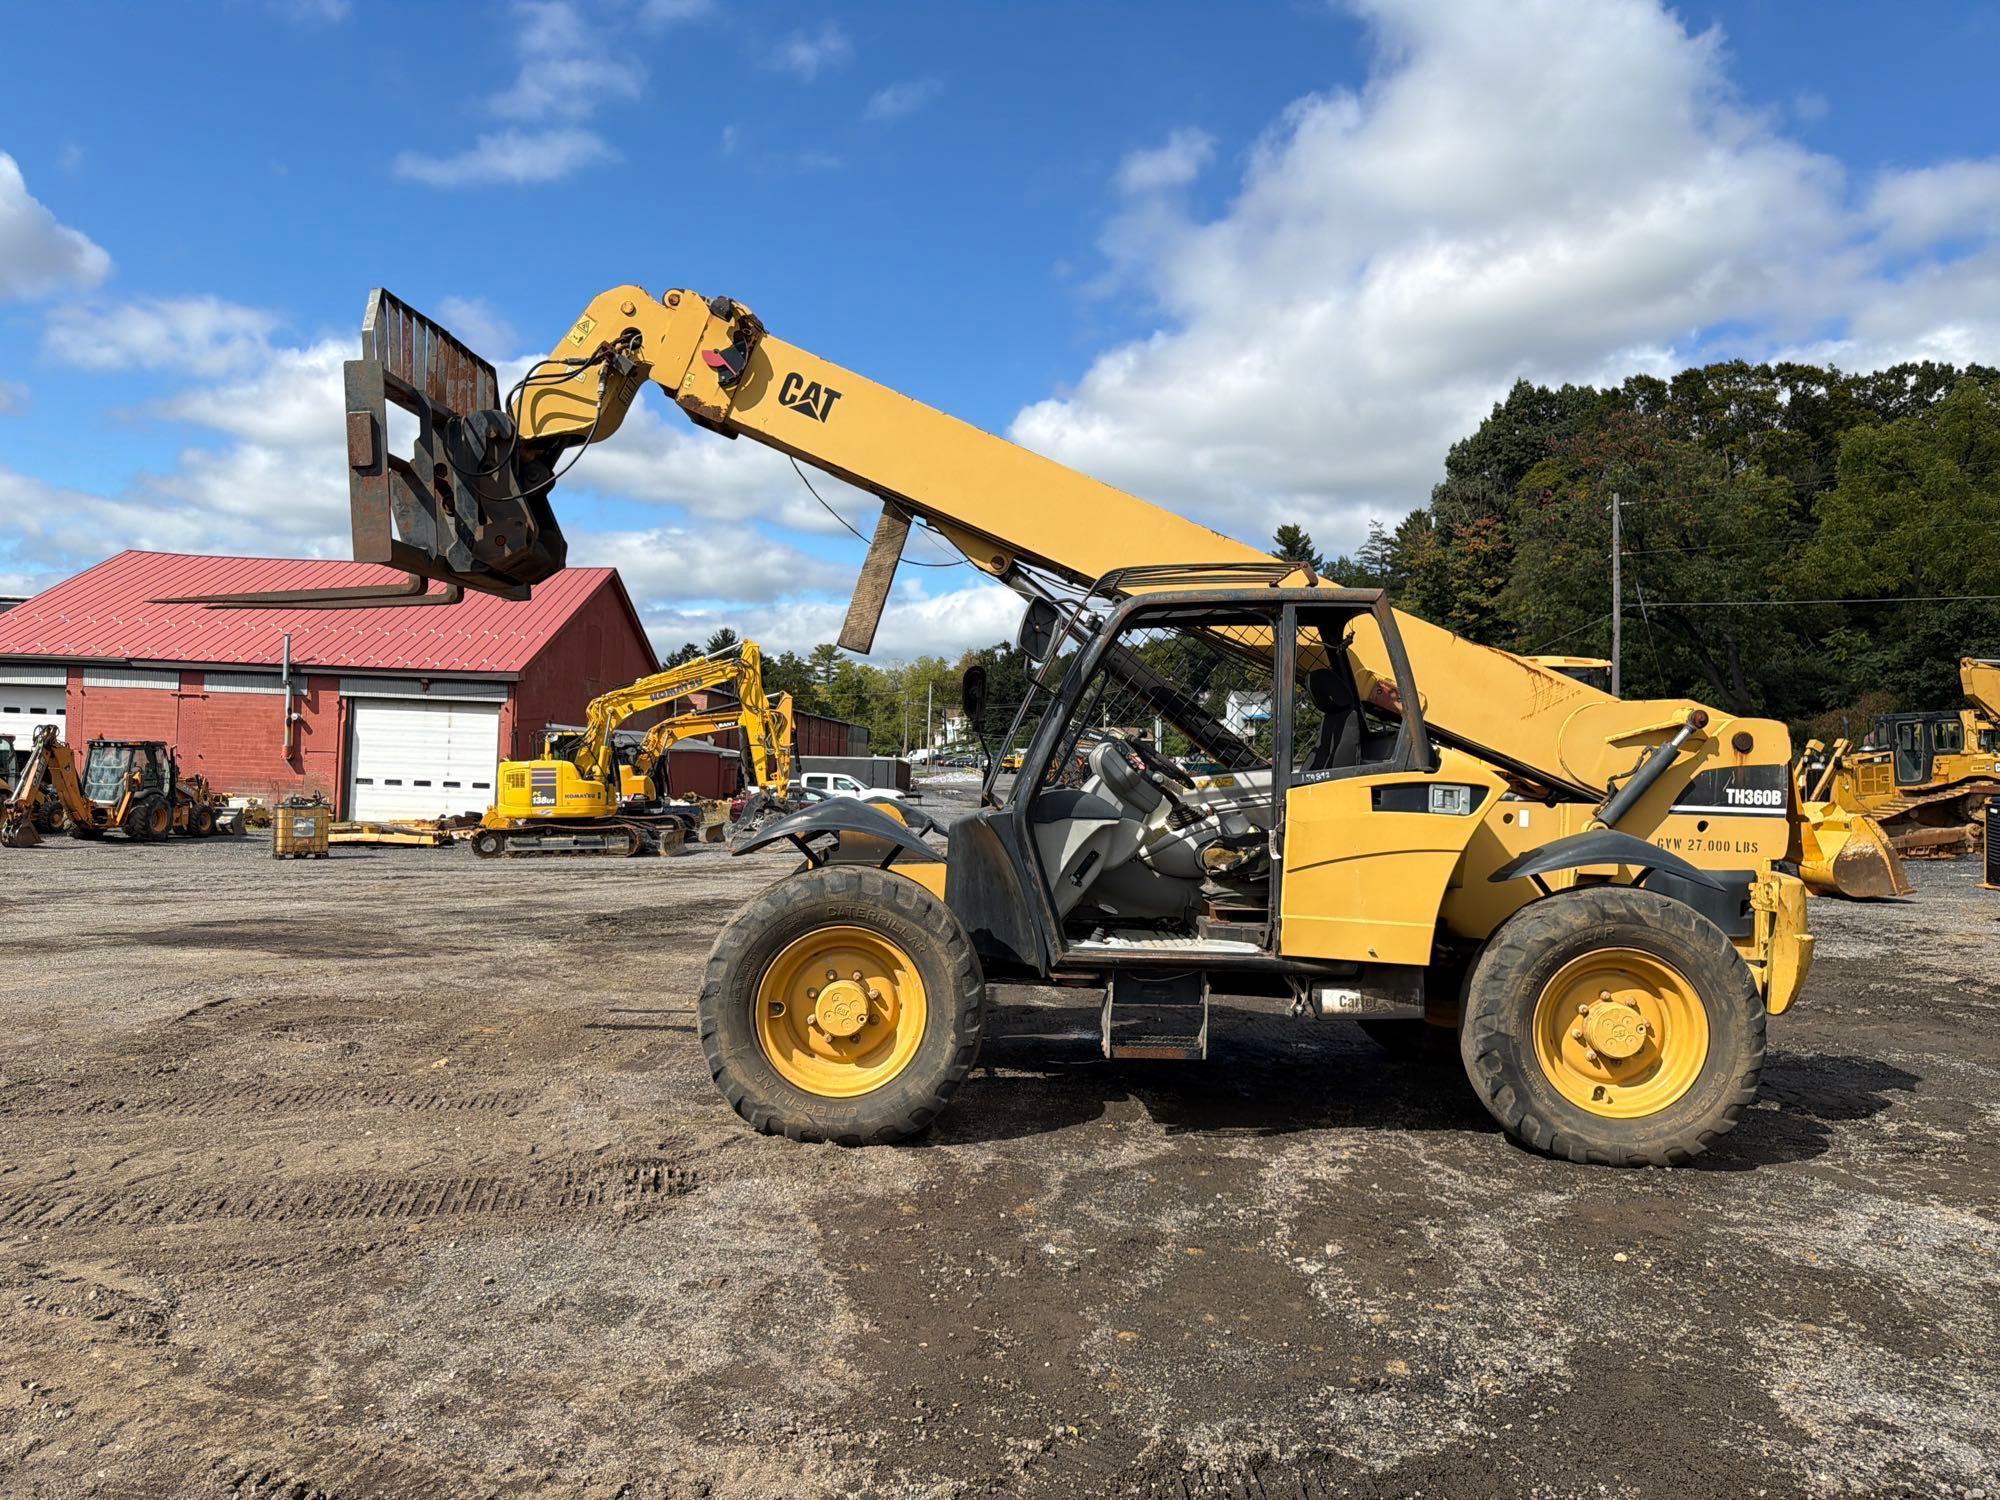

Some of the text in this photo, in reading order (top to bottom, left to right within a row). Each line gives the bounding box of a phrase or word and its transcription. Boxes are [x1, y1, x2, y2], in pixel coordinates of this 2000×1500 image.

[778, 372, 842, 423] CAT
[1726, 788, 1782, 805] TH360B
[1735, 841, 1759, 853] LBS
[826, 905, 927, 953] CATERPILLAR
[1339, 995, 1378, 1008] Carter
[754, 1069, 859, 1119] CATERPILLAR
